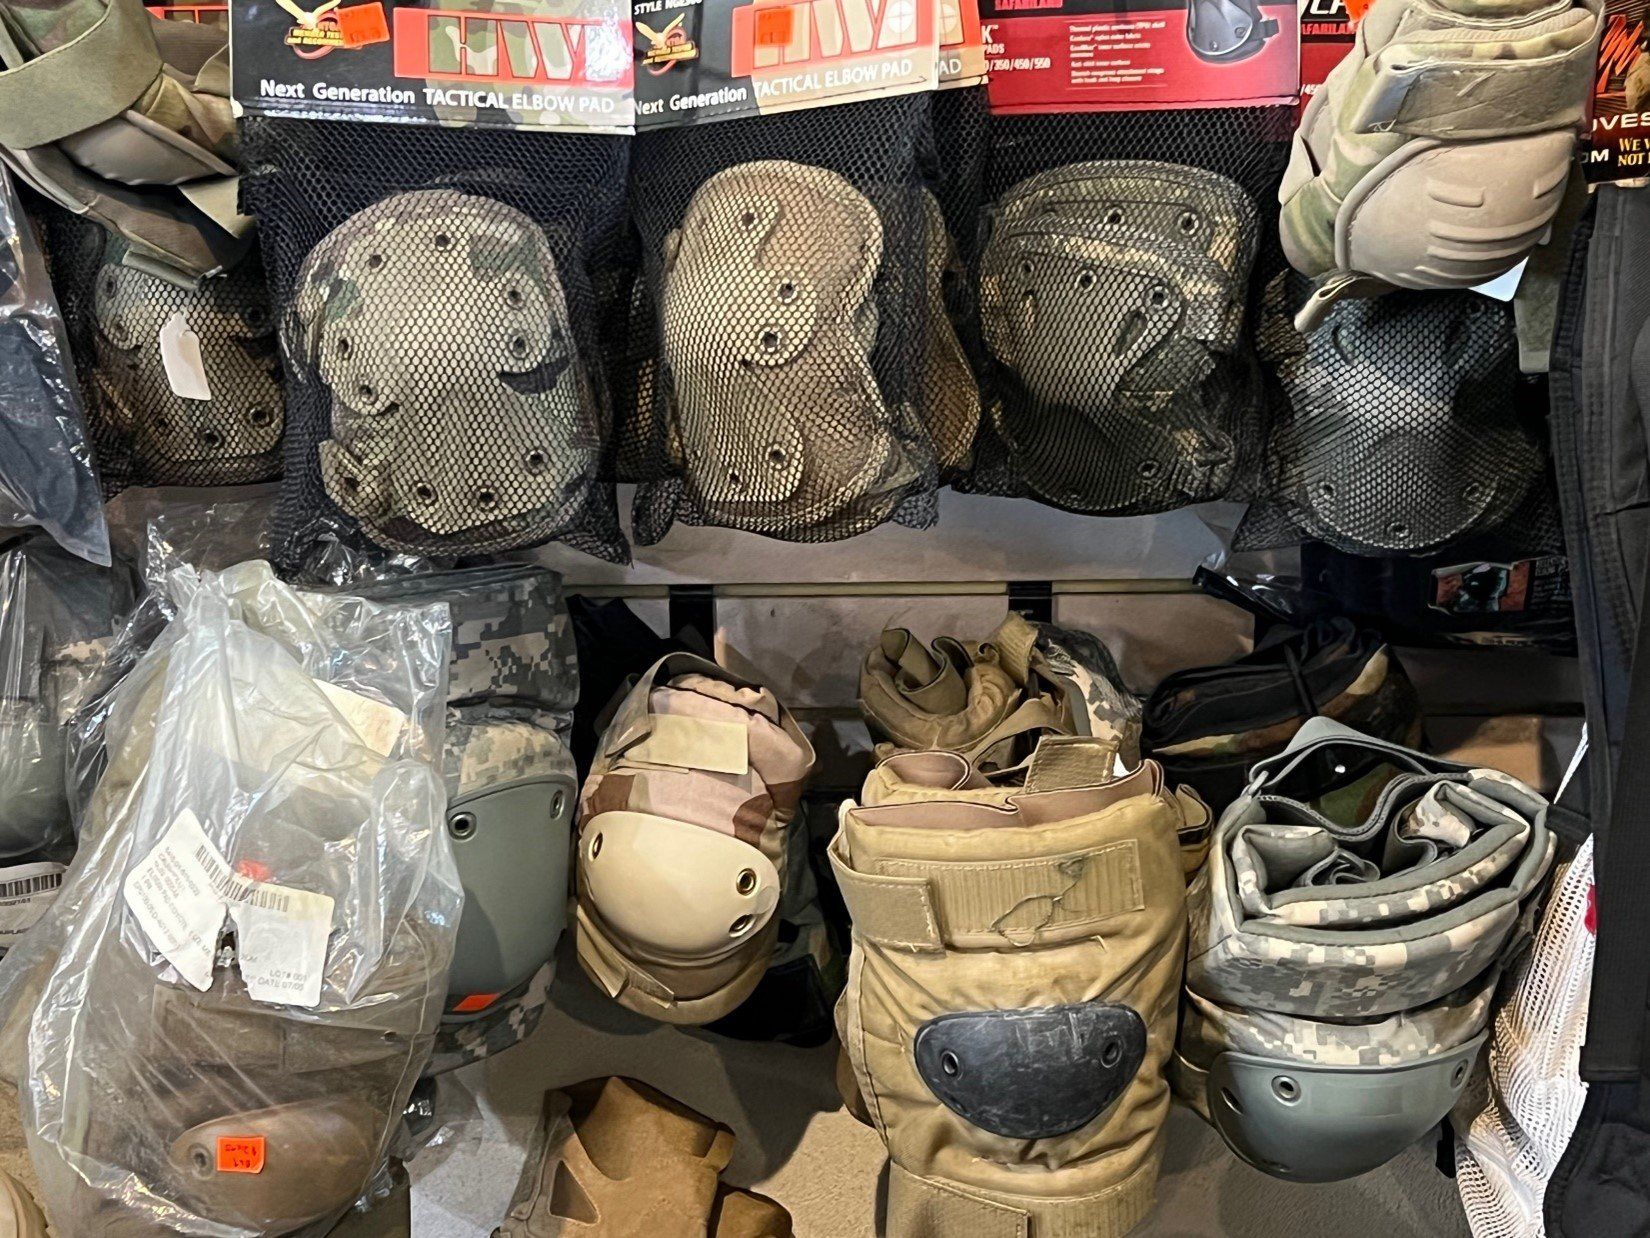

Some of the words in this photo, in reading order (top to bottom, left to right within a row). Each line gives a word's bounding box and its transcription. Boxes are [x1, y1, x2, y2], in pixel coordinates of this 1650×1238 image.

[937, 58, 962, 75] AD
[669, 86, 747, 111] Generation
[754, 72, 821, 98] TACTICAL
[825, 63, 878, 88] ELBOW
[881, 58, 913, 80] PAD
[260, 79, 306, 99] Next
[312, 82, 416, 104] Generation
[423, 88, 509, 110] TACTICAL
[512, 93, 574, 112] ELBOW
[579, 97, 615, 113] PAD
[1619, 137, 1642, 152] WE
[1618, 152, 1645, 167] NOT
